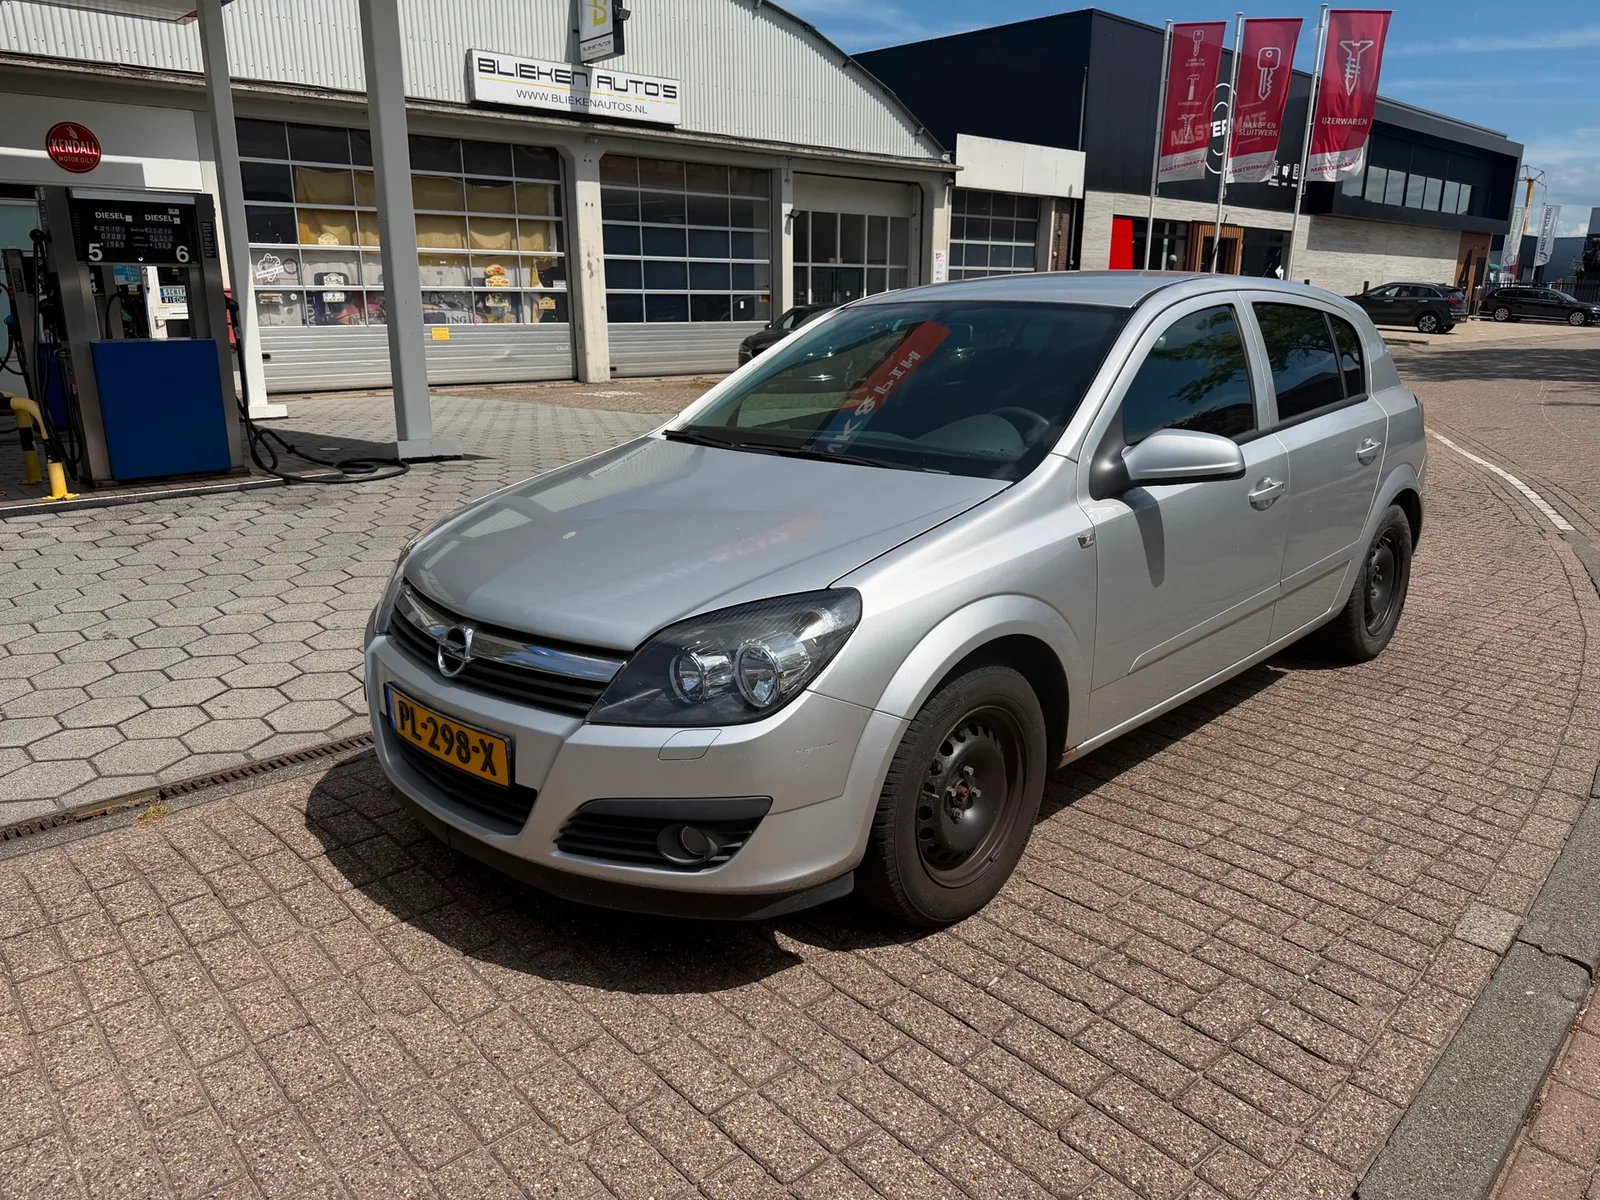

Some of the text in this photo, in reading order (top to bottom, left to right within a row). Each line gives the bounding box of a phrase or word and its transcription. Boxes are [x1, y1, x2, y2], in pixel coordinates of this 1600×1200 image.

[477, 57, 678, 99] BLIEKEN AUTO'S
[515, 89, 648, 115] WWW.BLIEKENAUTOS.NL
[1321, 116, 1368, 125] IJZERWAREN
[1238, 128, 1279, 137] SLUITWERK
[51, 138, 98, 155] KENDALL
[58, 155, 80, 163] MOTOR
[94, 211, 126, 220] DIESEL
[144, 214, 173, 222] DIESEL
[88, 243, 103, 262] 5
[175, 245, 190, 263] 6
[142, 267, 149, 276] 2
[397, 699, 498, 777] PL-298-X
